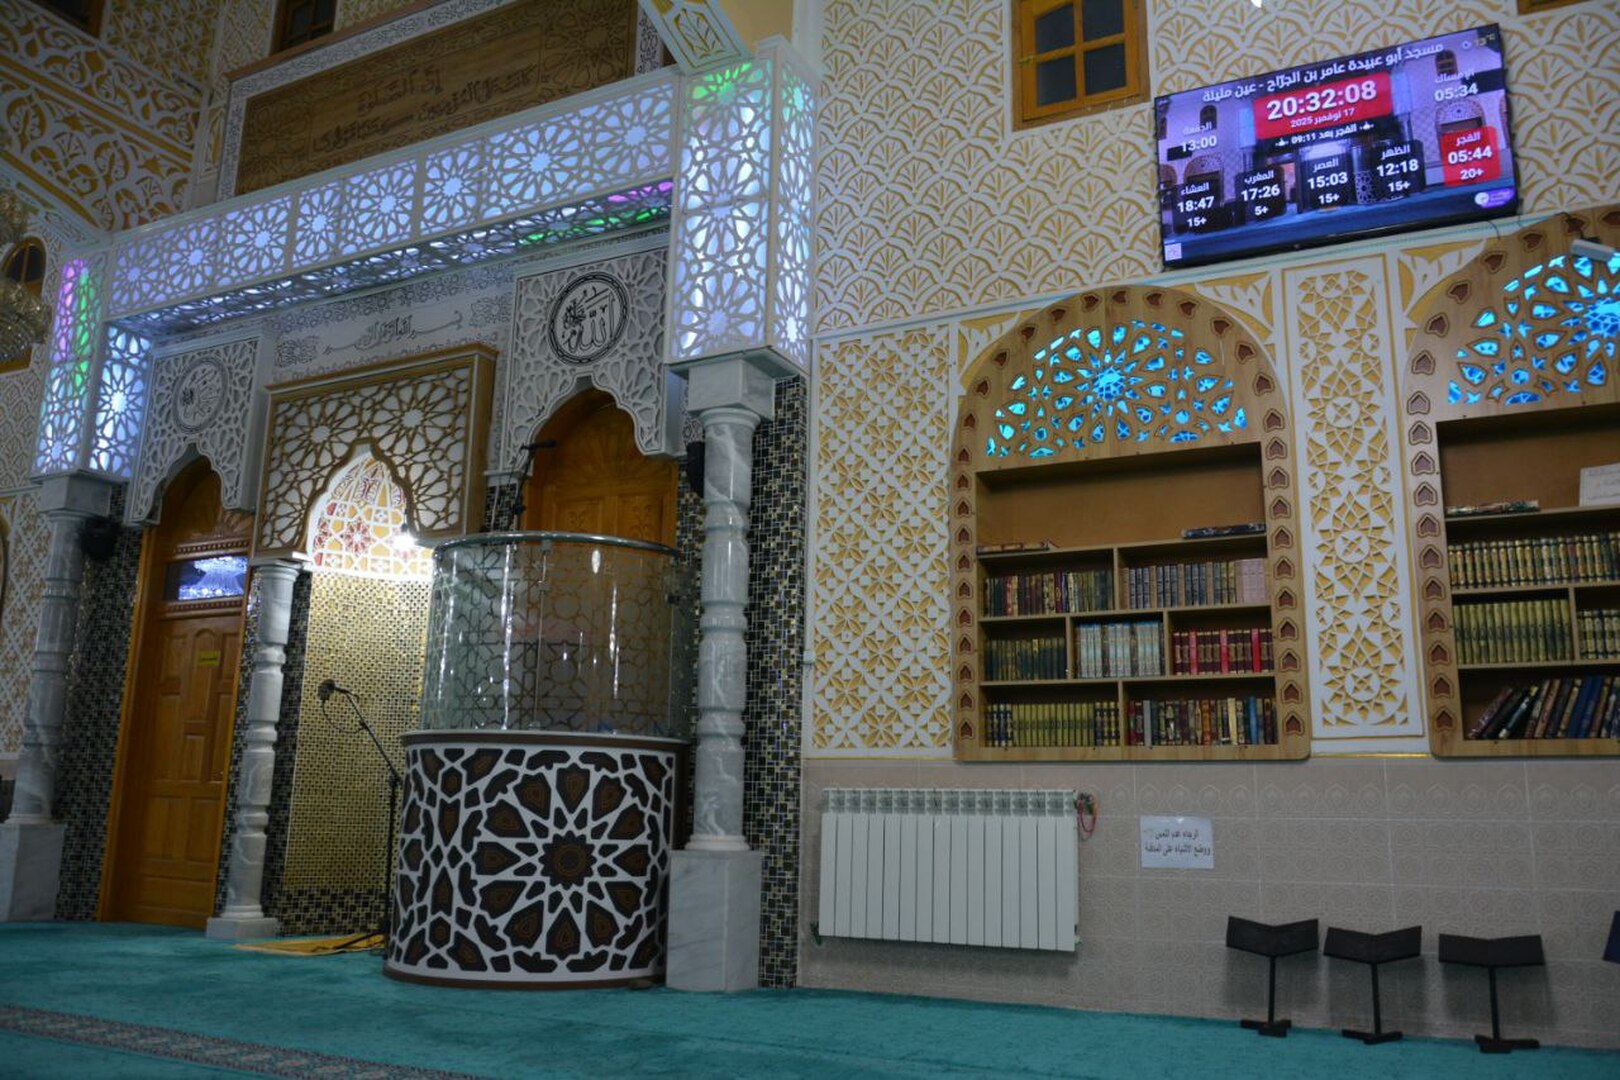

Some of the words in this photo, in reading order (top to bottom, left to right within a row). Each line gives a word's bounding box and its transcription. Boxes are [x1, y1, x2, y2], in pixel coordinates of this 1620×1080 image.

[1385, 47, 1403, 69] أبو
[1405, 43, 1444, 59] مسجد
[1348, 56, 1384, 72] عبيدة
[1304, 68, 1319, 83] بن
[1320, 64, 1346, 81] عامر
[1202, 89, 1234, 103] مليلة
[1234, 85, 1257, 98] عين
[1434, 82, 1479, 102] 05:34
[1267, 80, 1377, 120] 20:32:08
[1343, 108, 1355, 117] 17
[1290, 116, 1313, 127] 2025
[1335, 123, 1357, 137] الفجر
[1180, 135, 1217, 152] 13:00
[1456, 131, 1481, 147] الفجر
[1381, 144, 1411, 160] الظهر
[1448, 145, 1493, 164] 05:44
[1313, 158, 1339, 173] العصر
[1376, 158, 1419, 177] 12:18
[1244, 169, 1274, 185] المغرب
[1307, 171, 1348, 190] 15:03
[1180, 182, 1210, 195] العشاء
[1241, 184, 1281, 201] 17:26
[1177, 195, 1215, 213] 18:47
